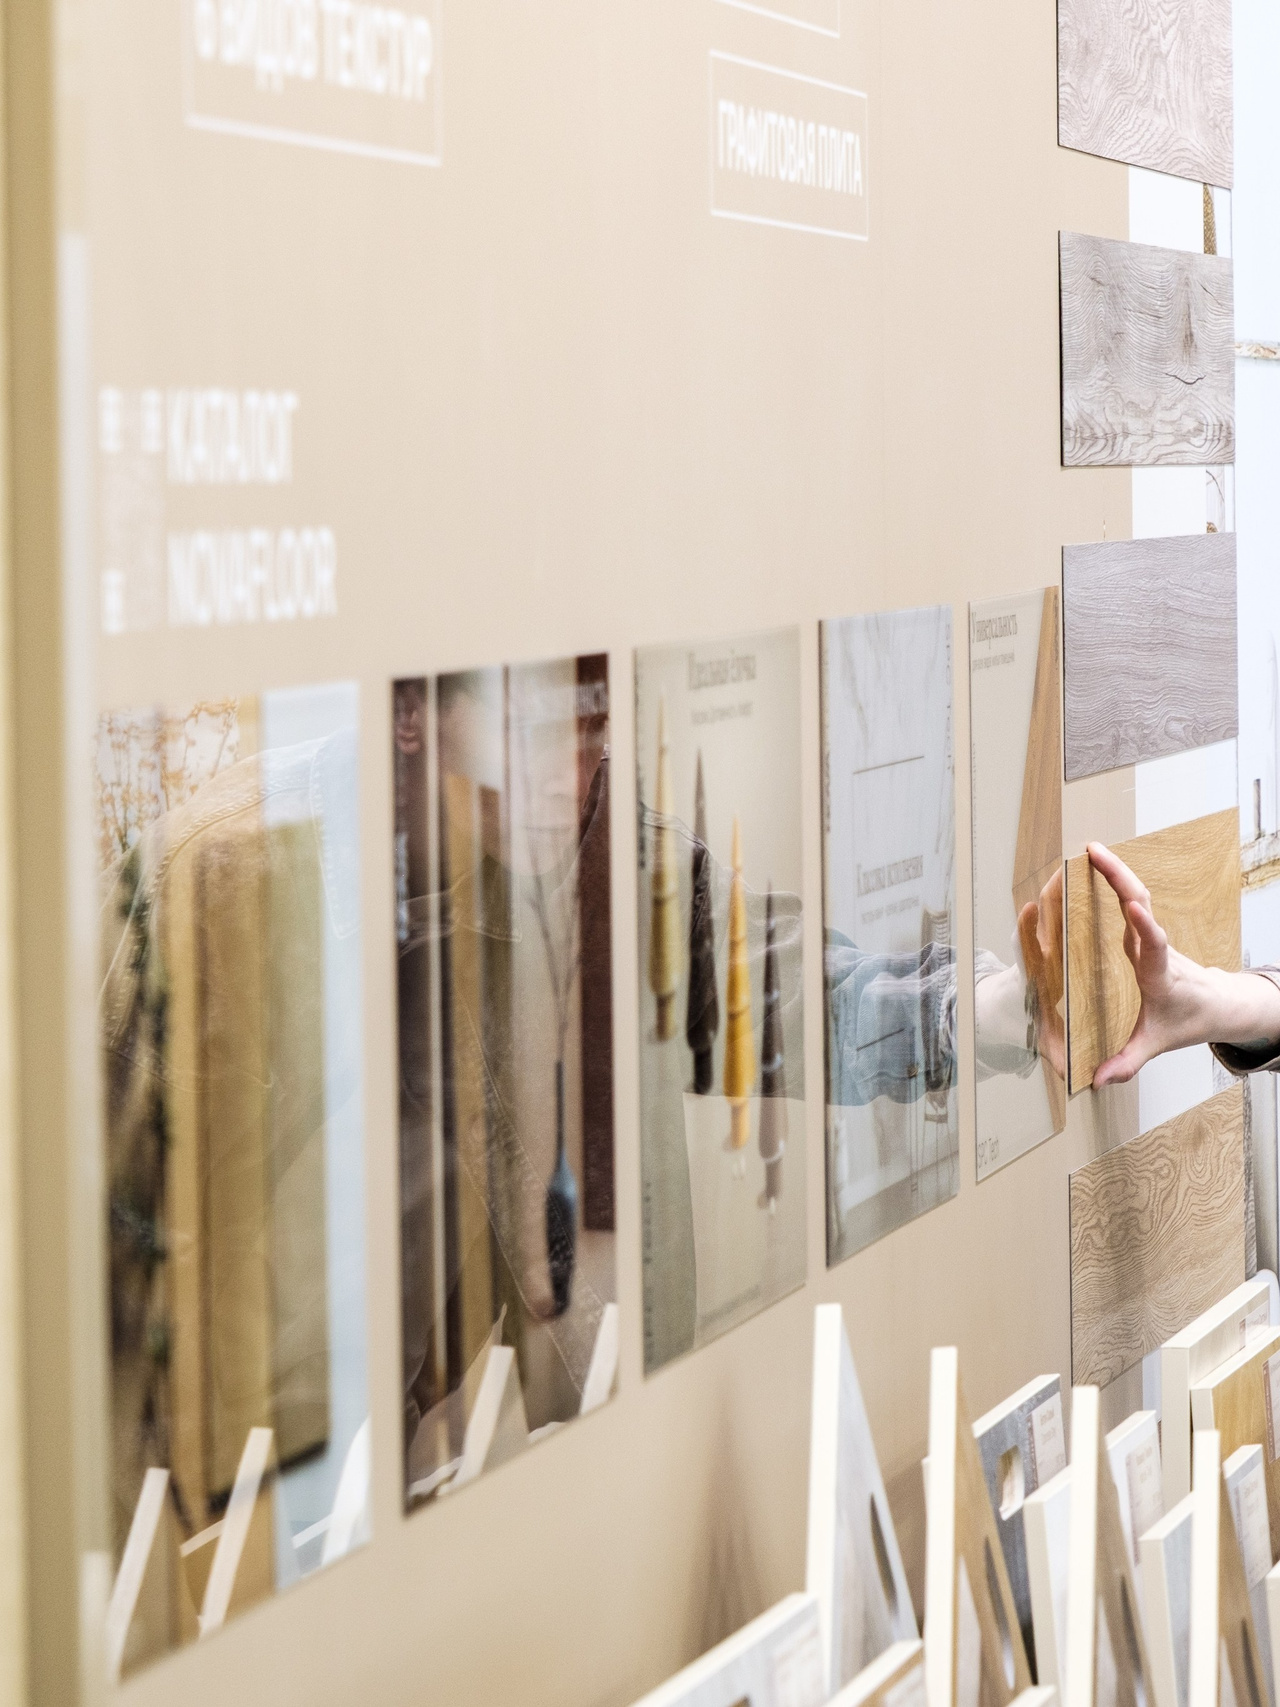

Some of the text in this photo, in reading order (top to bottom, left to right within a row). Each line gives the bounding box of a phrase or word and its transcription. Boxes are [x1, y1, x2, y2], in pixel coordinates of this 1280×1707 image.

[718, 99, 863, 196] ГРАФИТОВАЯ ПЛИТА
[166, 385, 300, 486] КАТАЛОГ
[167, 525, 338, 626] NOVAFLOOR
